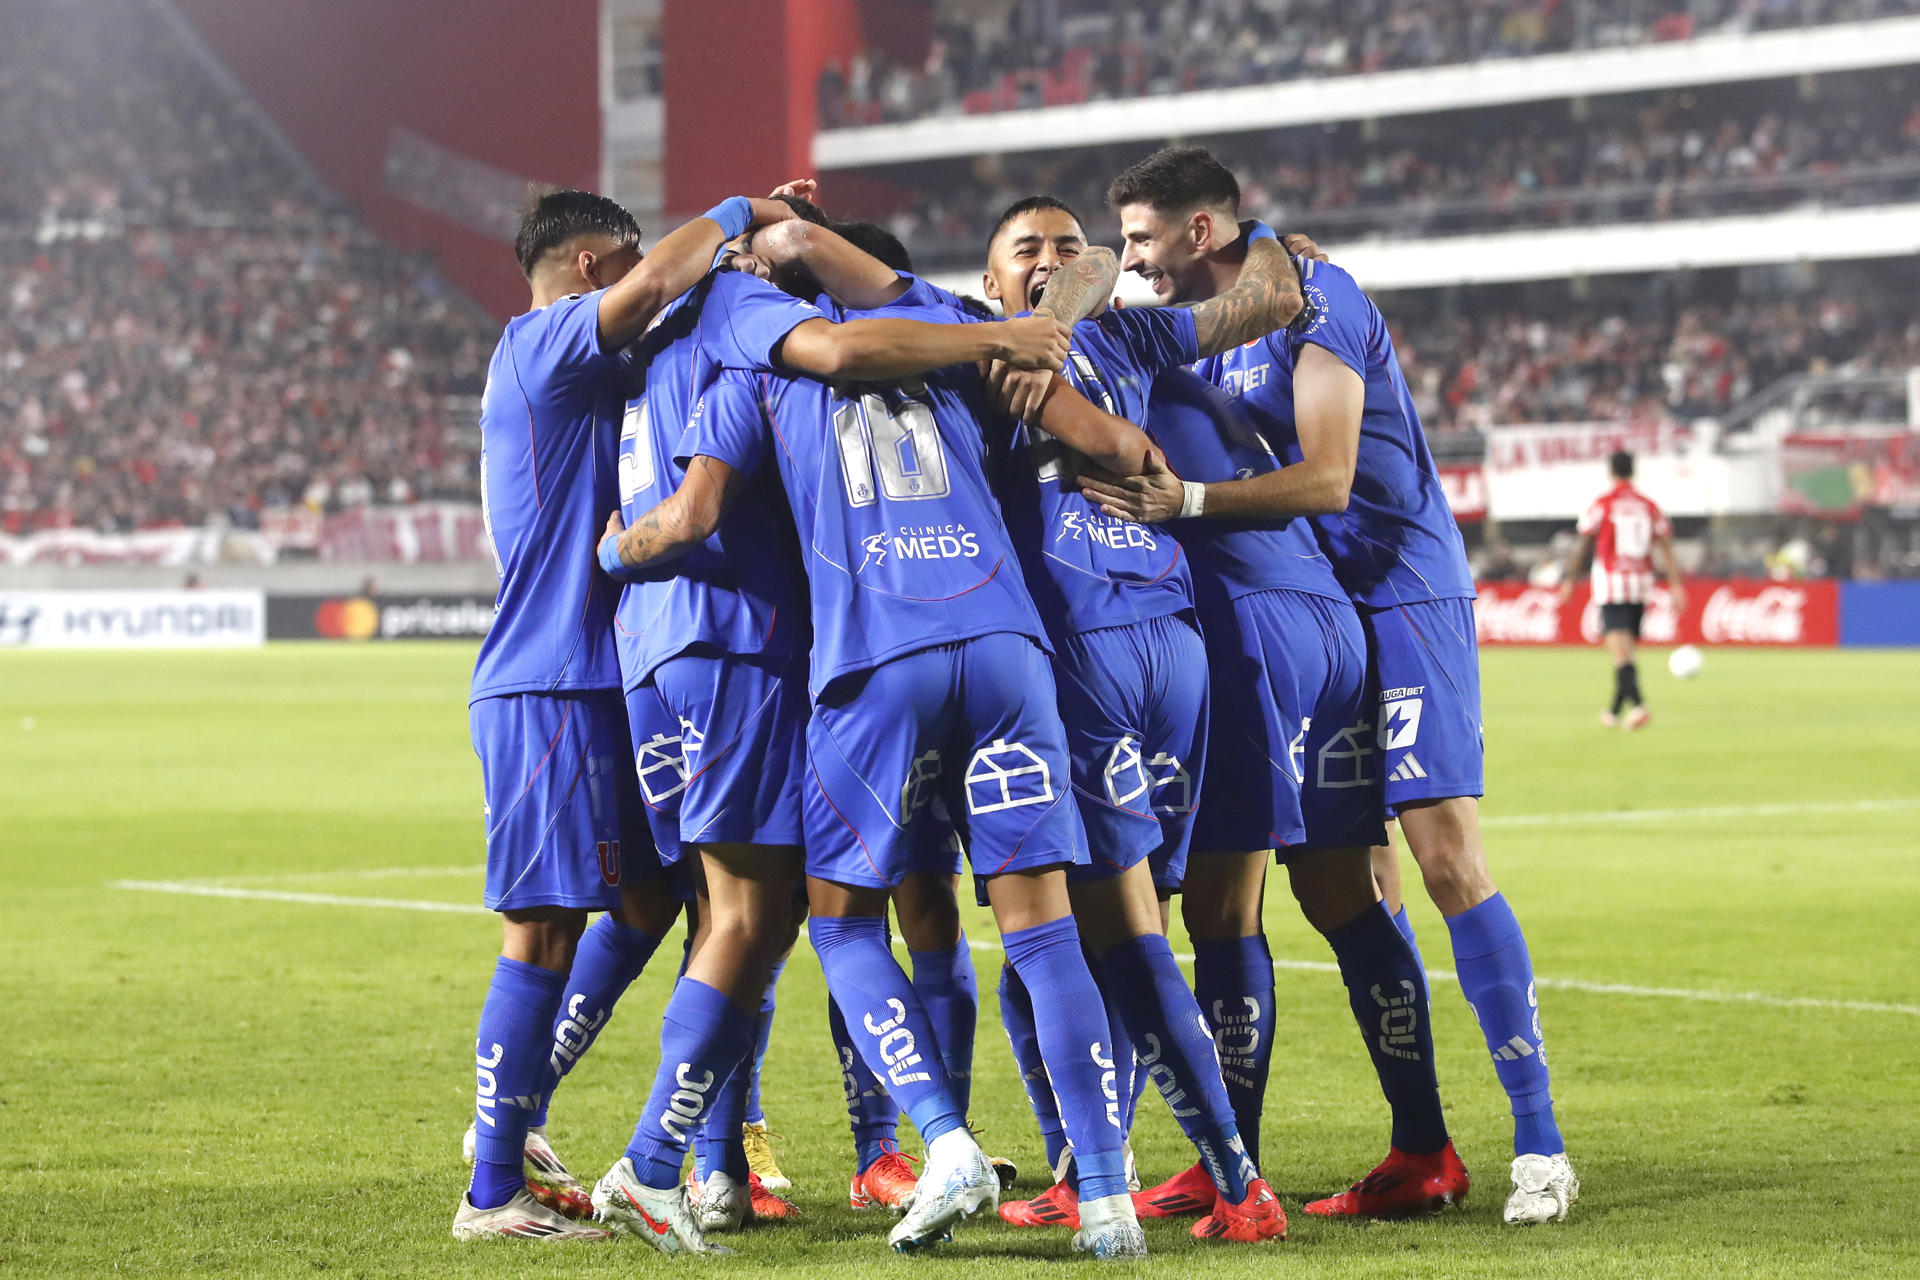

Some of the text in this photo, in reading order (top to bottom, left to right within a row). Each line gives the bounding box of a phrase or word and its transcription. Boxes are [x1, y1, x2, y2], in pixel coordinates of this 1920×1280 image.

[900, 524, 966, 535] CLINICA
[1090, 515, 1142, 526] CLIN
[893, 532, 980, 560] MEDS
[1085, 522, 1157, 551] MEDS
[64, 601, 252, 637] HYUNDAI
